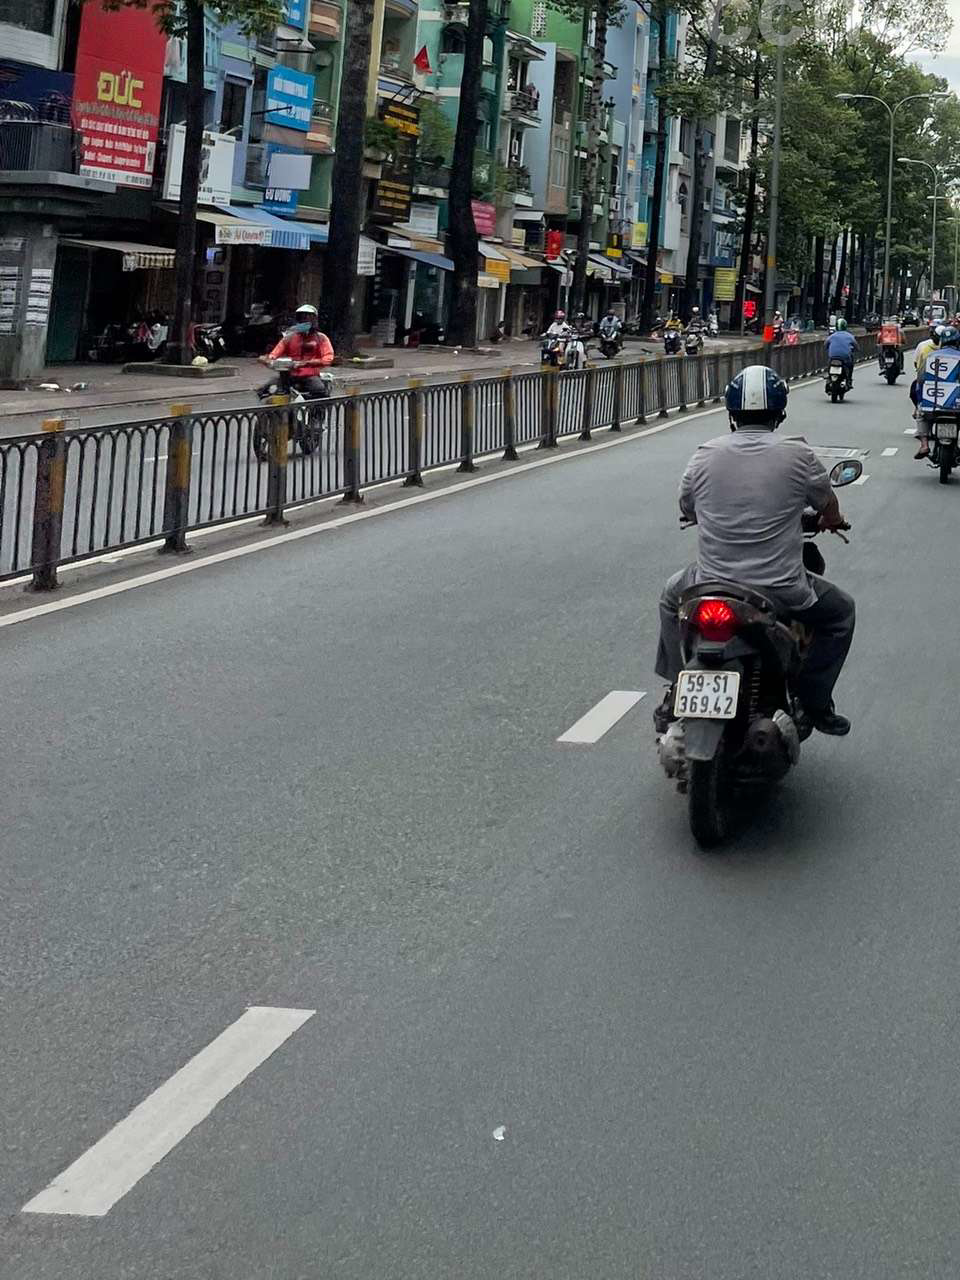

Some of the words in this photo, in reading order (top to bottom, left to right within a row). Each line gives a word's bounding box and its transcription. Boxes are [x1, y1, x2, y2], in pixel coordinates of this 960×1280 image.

[926, 387, 945, 397] GS
[687, 674, 729, 693] 59-S1
[679, 695, 734, 715] 369.42
